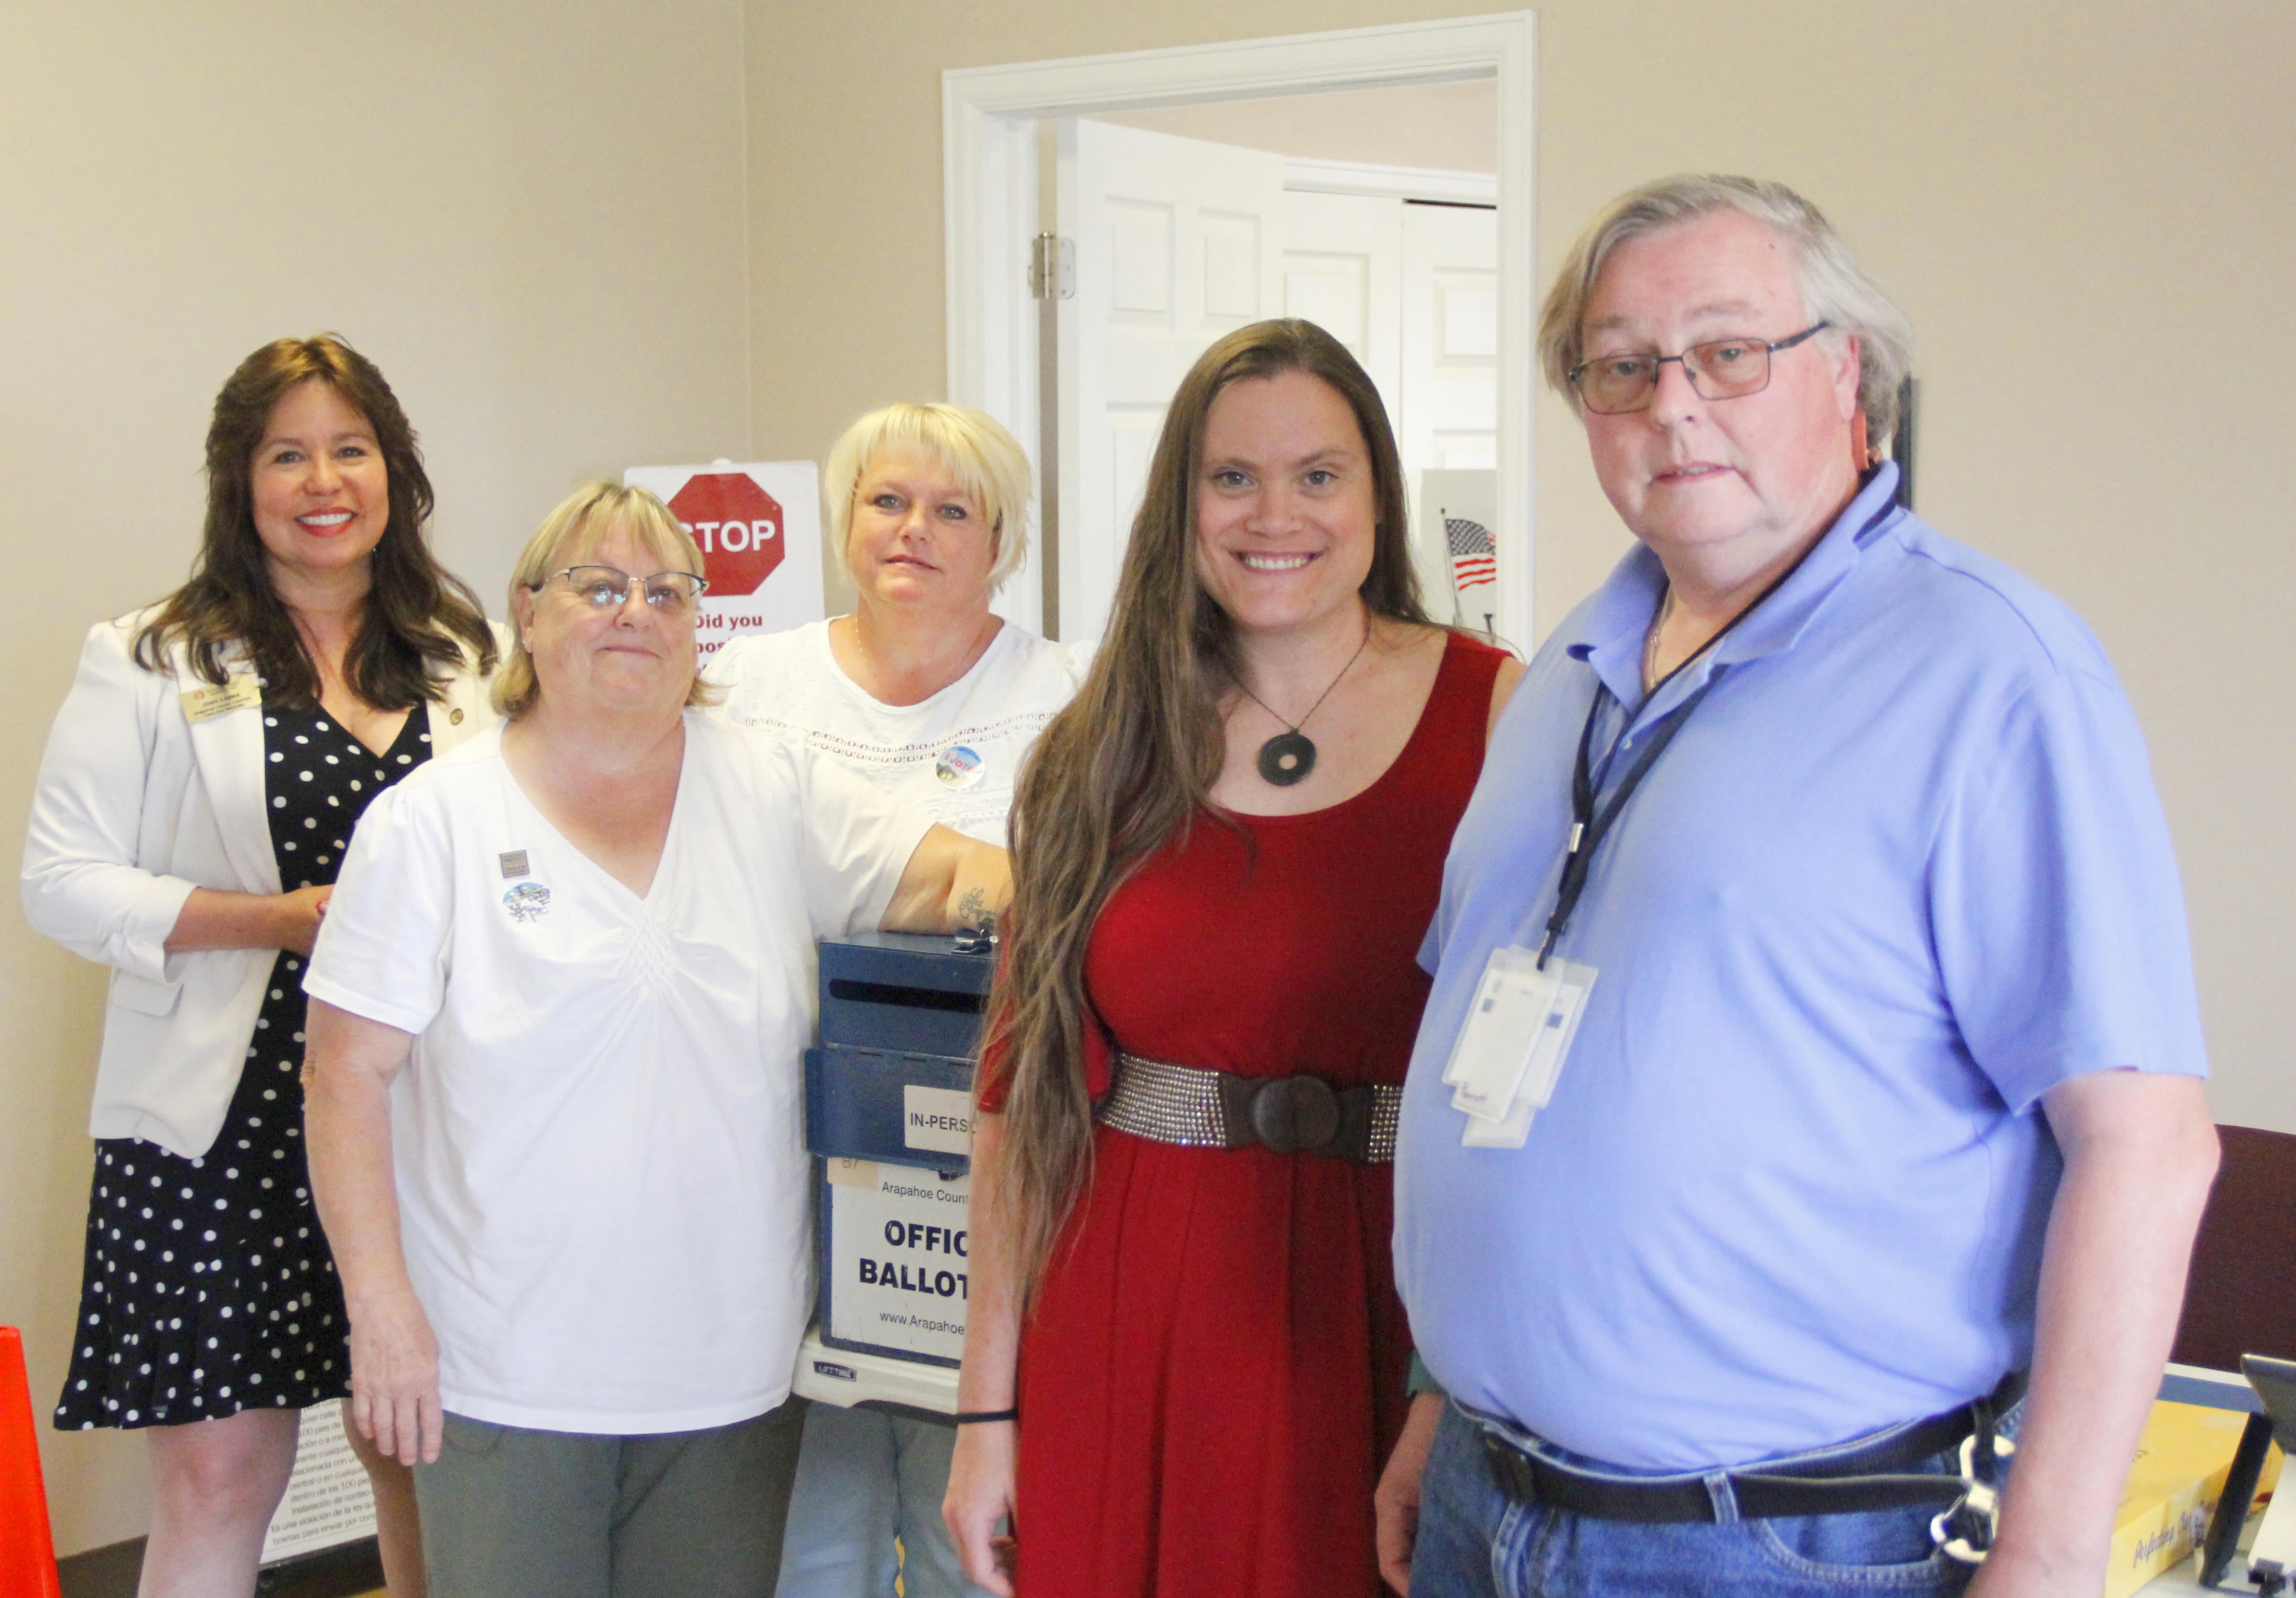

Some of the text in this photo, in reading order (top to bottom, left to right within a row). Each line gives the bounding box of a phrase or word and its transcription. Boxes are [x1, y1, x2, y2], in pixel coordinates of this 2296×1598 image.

[681, 520, 776, 553] TOP
[729, 616, 762, 631] you
[882, 1182, 933, 1199] Arapahoe
[302, 1527, 320, 1539] para
